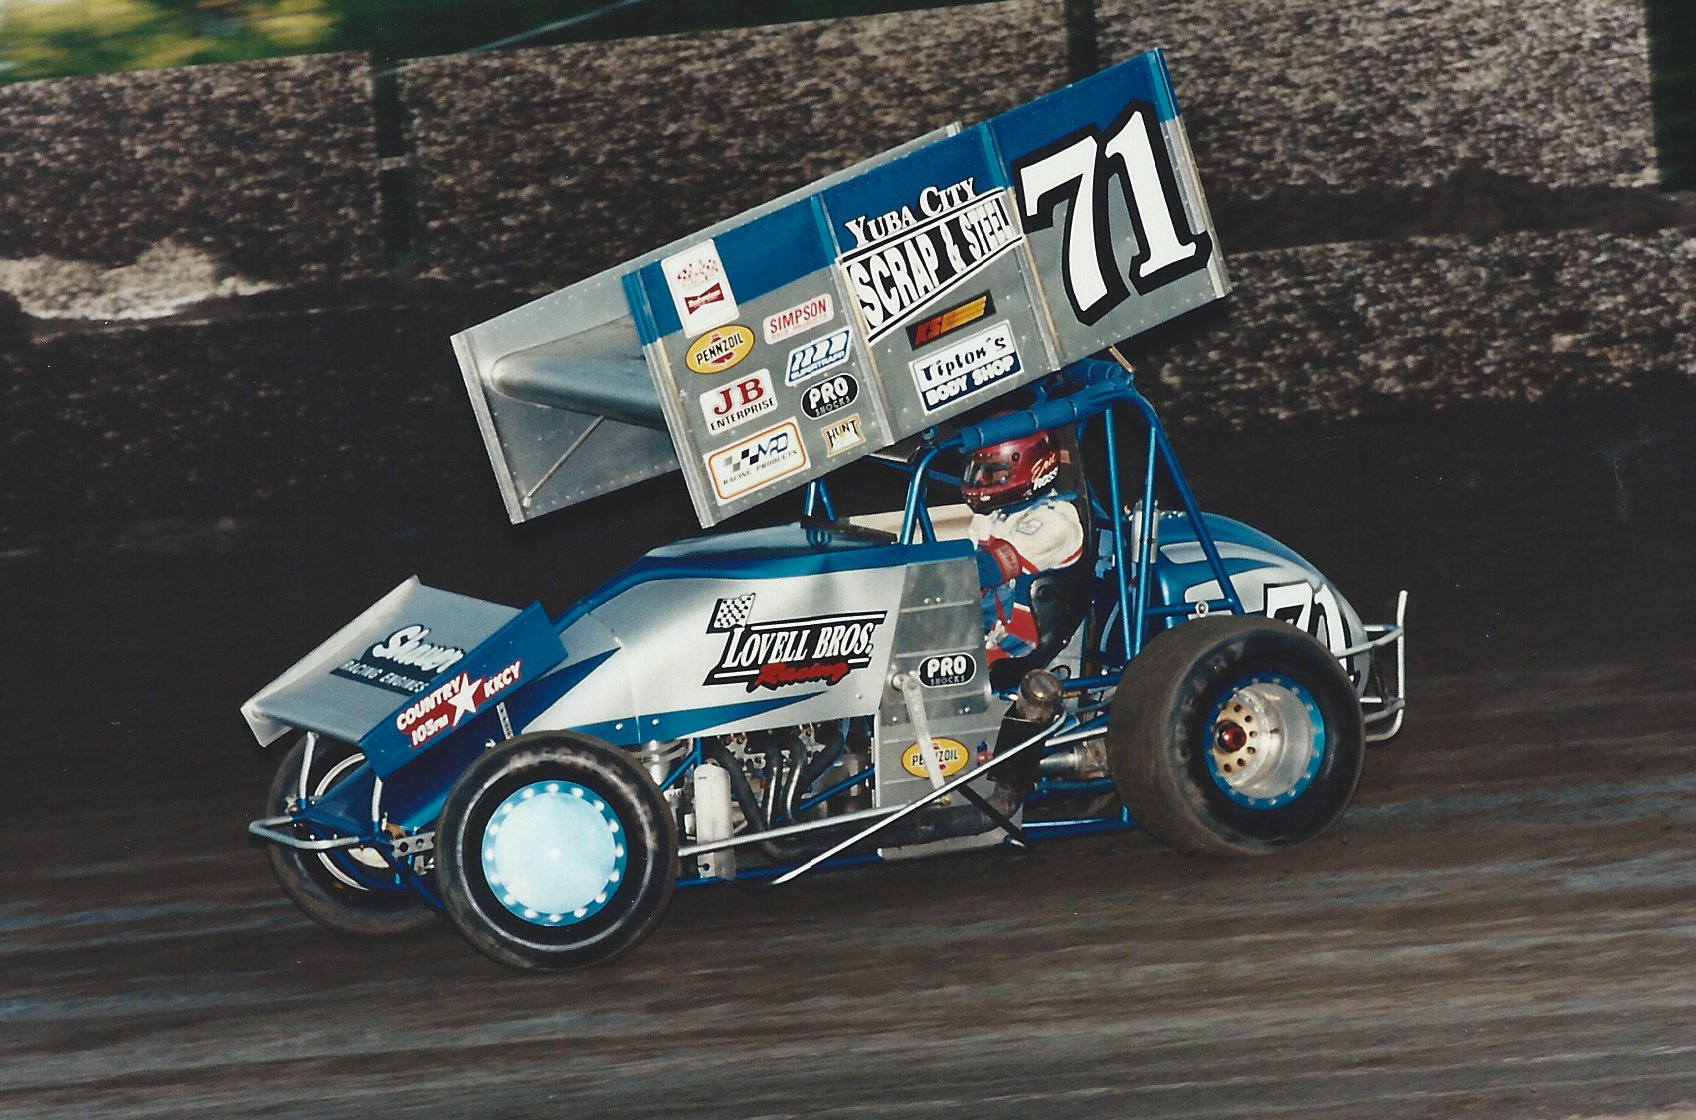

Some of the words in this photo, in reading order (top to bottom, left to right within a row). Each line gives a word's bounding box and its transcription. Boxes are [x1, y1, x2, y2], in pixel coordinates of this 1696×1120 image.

[845, 205, 917, 248] YUBA
[920, 177, 977, 217] CITY
[1017, 107, 1200, 315] 71
[850, 233, 940, 326] SCRAP
[939, 224, 967, 274] &
[958, 197, 1016, 261] STEEL
[770, 299, 826, 334] SIMPSON
[696, 332, 744, 366] PENNZOIL
[713, 377, 764, 415] JB
[808, 376, 849, 410] PRO
[926, 375, 968, 406] BODY
[972, 355, 1014, 386] SHOP
[710, 397, 775, 431] ENTERPRISE
[815, 396, 851, 417] SHOCKS
[827, 419, 859, 447] HUNT
[756, 449, 799, 472] PRODUCTS
[722, 627, 811, 668] LOVELL
[927, 655, 967, 679] PRO
[930, 675, 965, 686] SHOCKS
[396, 675, 461, 731] COUNTRY
[483, 660, 520, 698] KKCY
[912, 748, 958, 767] PEZOIL
